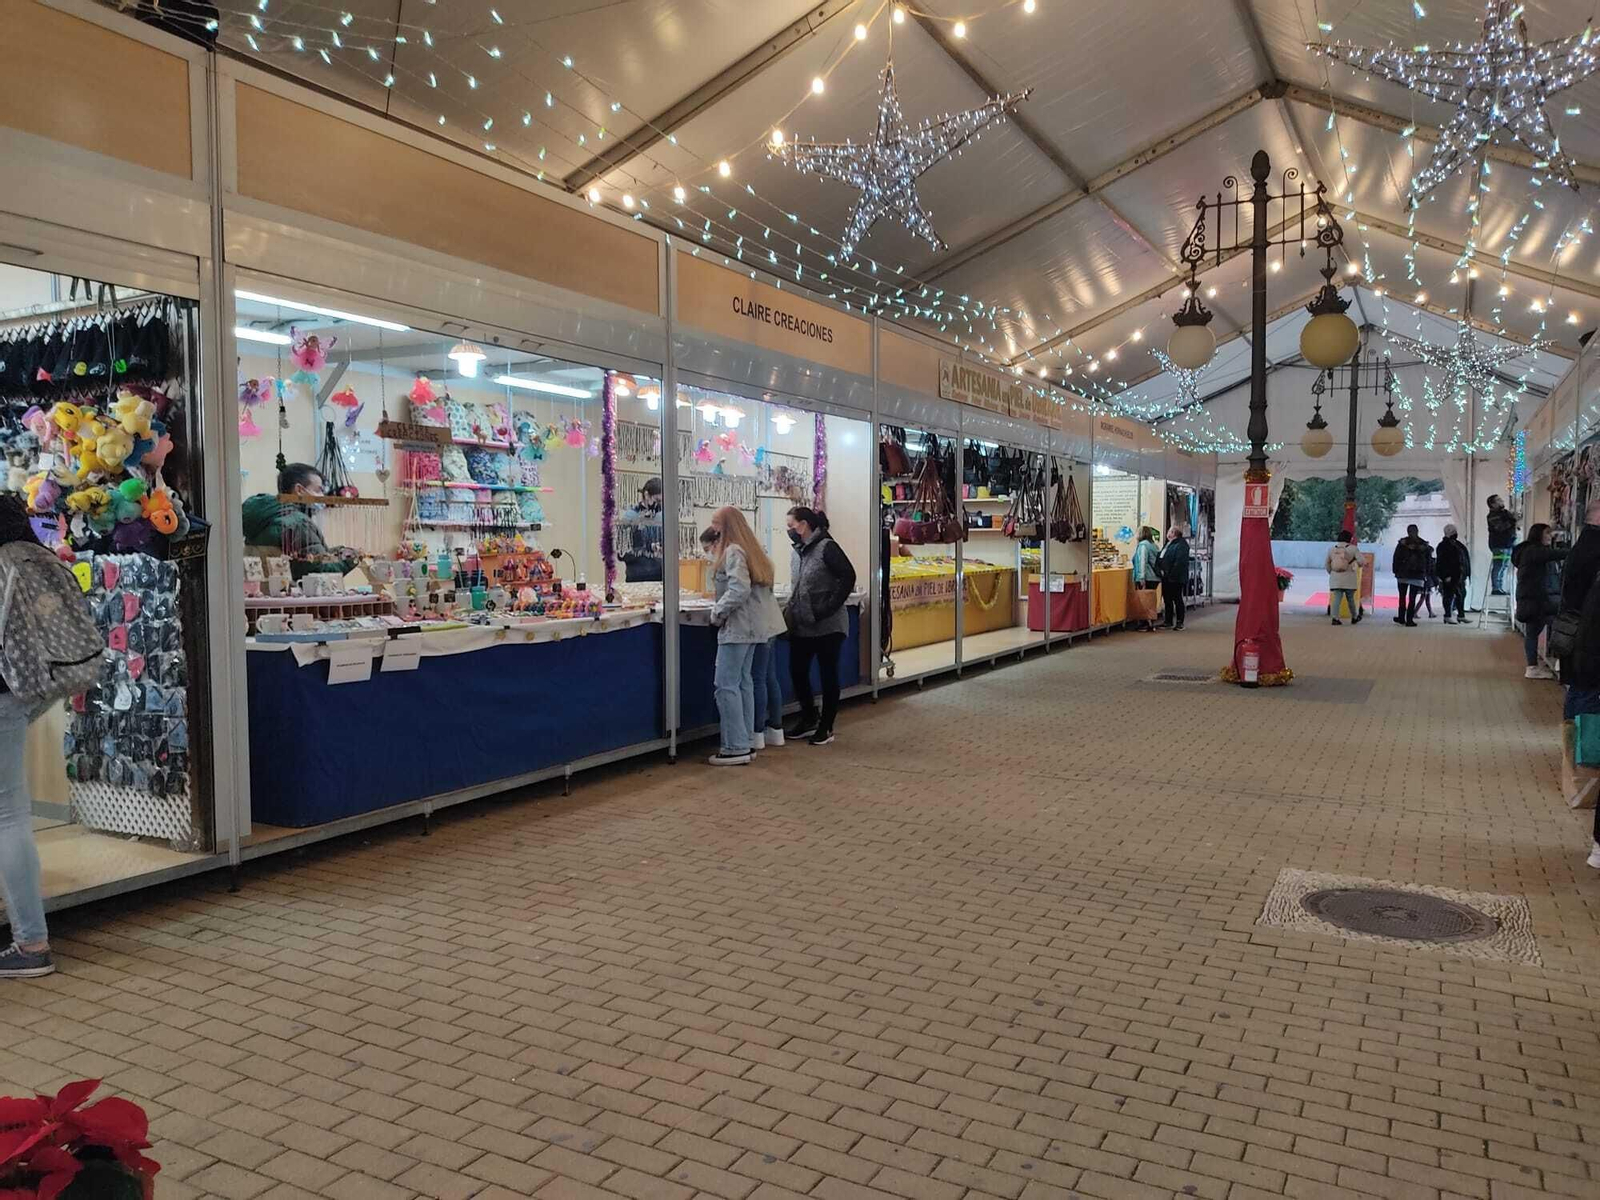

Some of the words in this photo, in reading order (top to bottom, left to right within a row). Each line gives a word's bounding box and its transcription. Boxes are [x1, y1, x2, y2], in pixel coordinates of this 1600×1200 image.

[732, 296, 771, 323] CLAIRE
[773, 310, 833, 343] CREACIONES
[890, 583, 915, 600] TESANIA
[923, 581, 936, 596] PIEL
